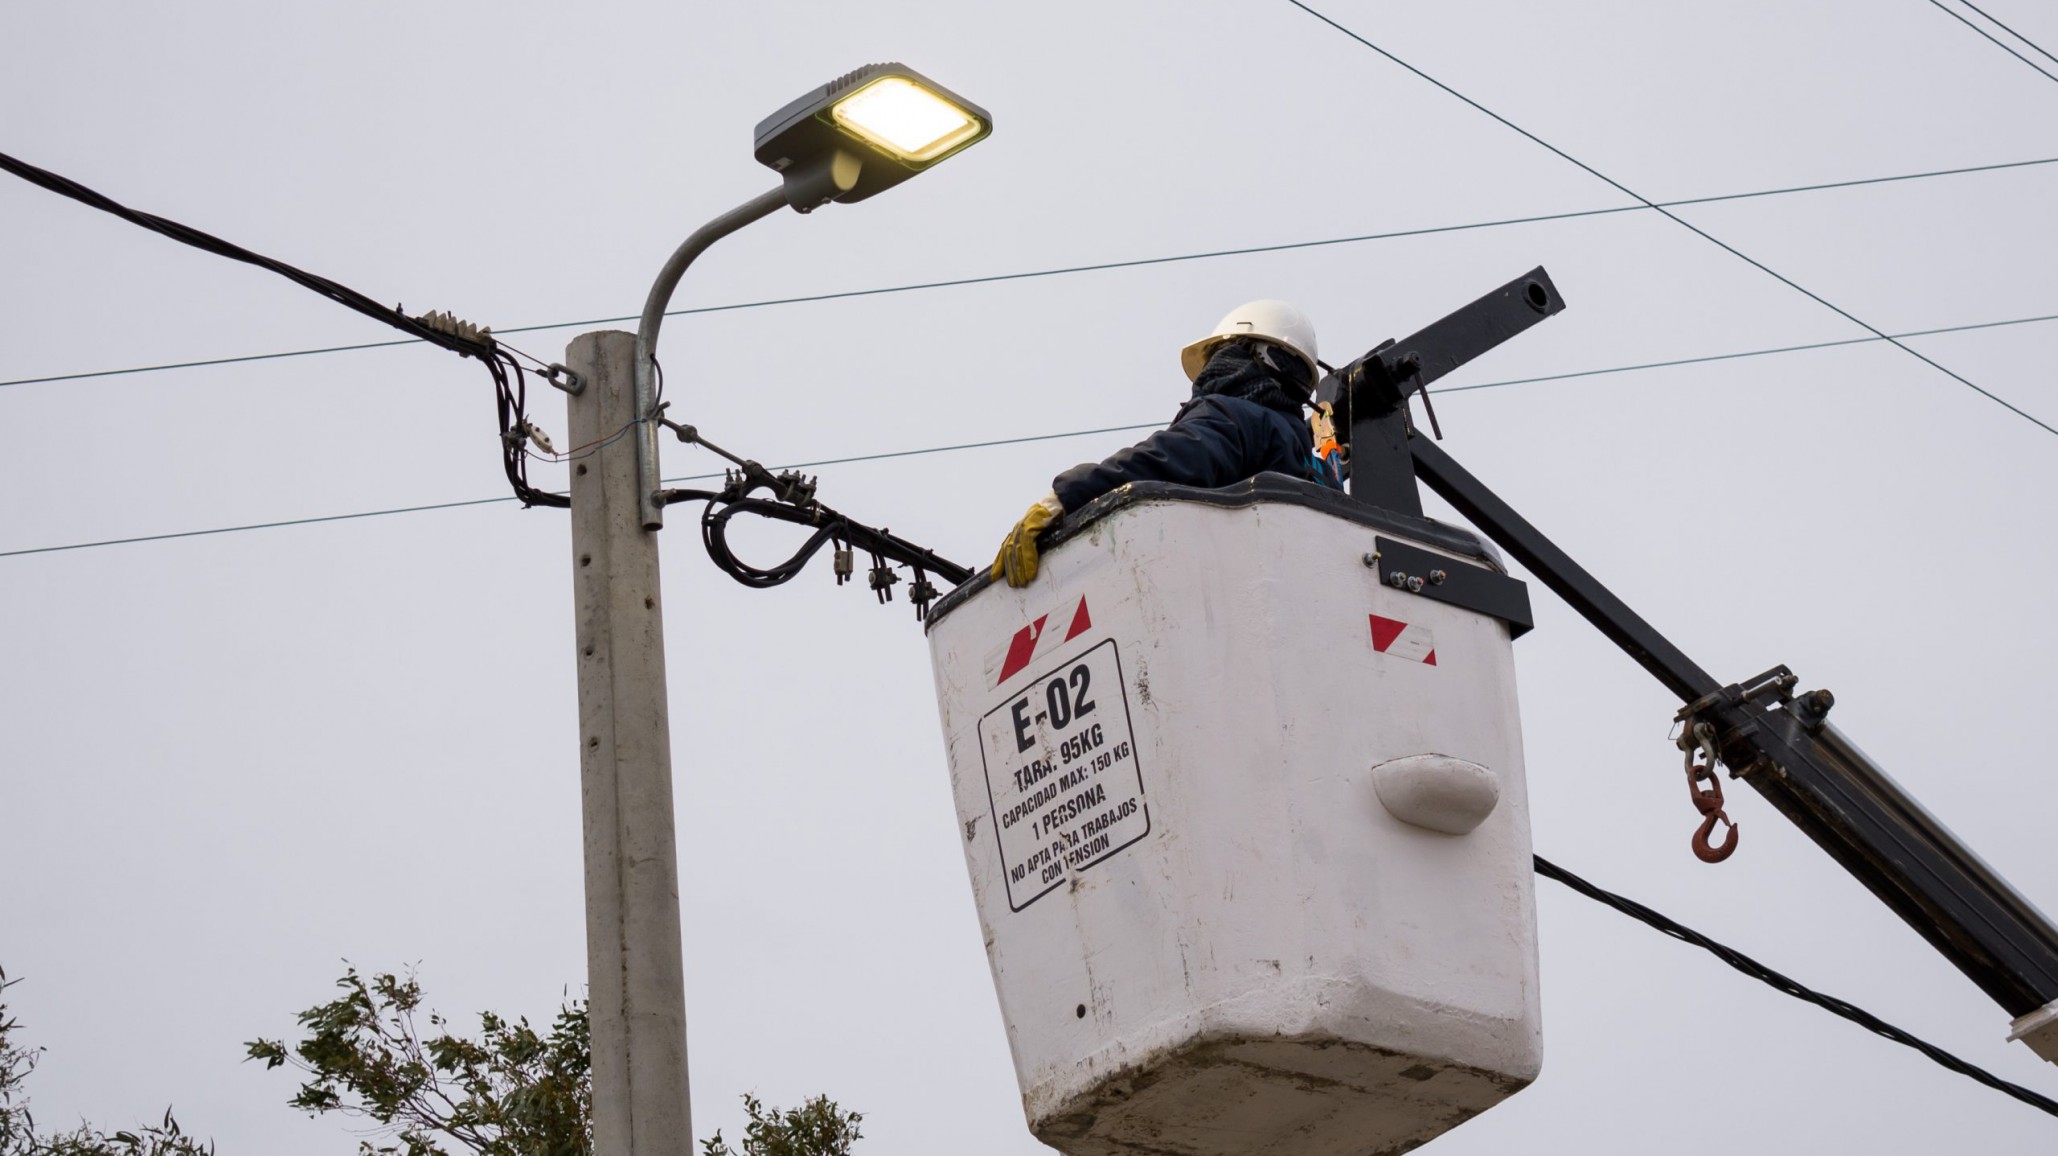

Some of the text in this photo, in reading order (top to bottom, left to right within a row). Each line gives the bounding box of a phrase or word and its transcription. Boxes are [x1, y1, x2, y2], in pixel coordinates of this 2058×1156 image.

[1011, 664, 1096, 754] E-02
[1060, 723, 1104, 765] 95KG
[1002, 741, 1130, 829] CAPACIDAD MAX: 150 KG
[1032, 783, 1106, 841] 1 PERSONA
[1010, 863, 1025, 884] NO
[1027, 847, 1051, 874] APTA
[1081, 797, 1138, 840] TRABAJOS
[1041, 860, 1063, 884] CON
